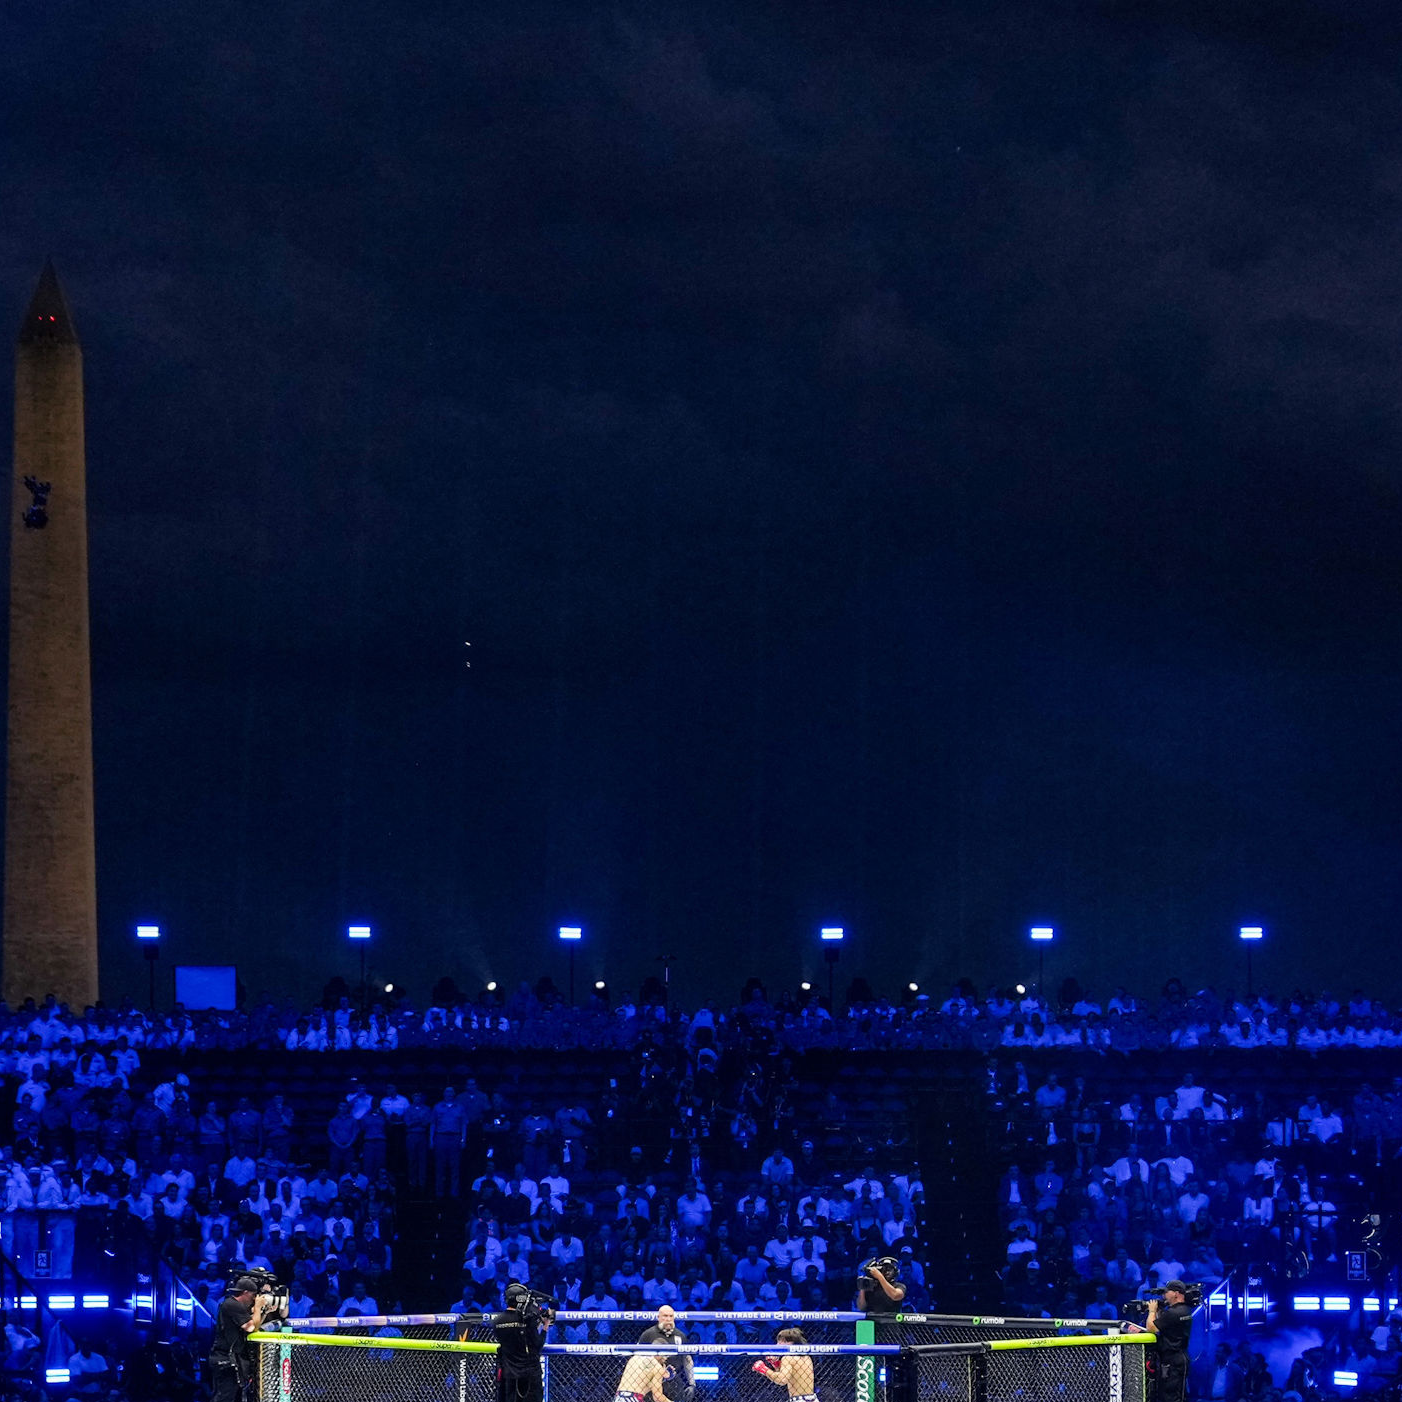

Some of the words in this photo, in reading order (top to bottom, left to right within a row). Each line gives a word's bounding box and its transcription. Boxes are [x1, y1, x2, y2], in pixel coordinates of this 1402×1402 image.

[389, 1315, 409, 1323] TRUTH
[437, 1314, 457, 1322] TRUTH
[636, 1311, 688, 1321] Polyket
[786, 1311, 838, 1321] Polymarket
[904, 1315, 927, 1323] rumble
[290, 1319, 310, 1327] TRUTH
[340, 1317, 359, 1325] TRUTH
[981, 1317, 1005, 1325] rumble
[1063, 1319, 1088, 1327] rumble
[565, 1345, 586, 1353] BUD
[587, 1345, 616, 1353] LIGHT
[677, 1345, 698, 1353] BUD
[699, 1345, 728, 1353] LIGHT
[789, 1345, 810, 1353] BUD
[811, 1345, 840, 1353] LIGHT
[459, 1358, 467, 1385] World
